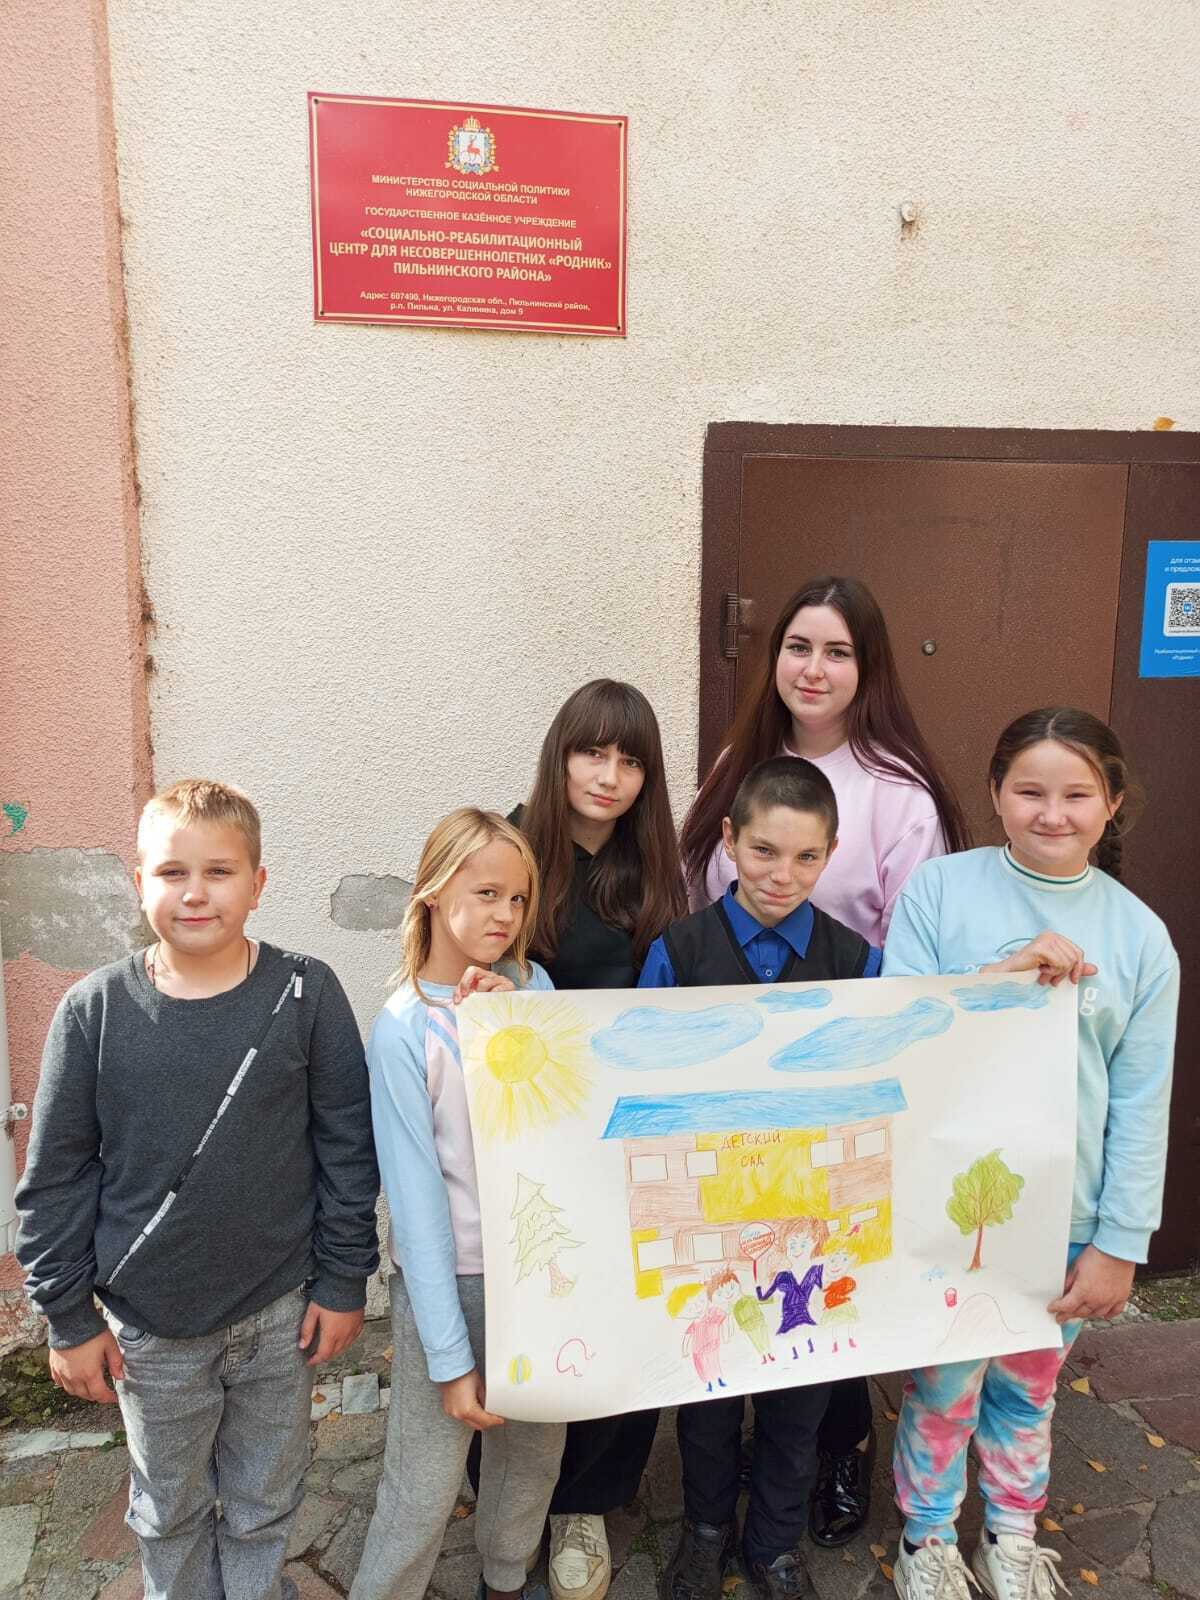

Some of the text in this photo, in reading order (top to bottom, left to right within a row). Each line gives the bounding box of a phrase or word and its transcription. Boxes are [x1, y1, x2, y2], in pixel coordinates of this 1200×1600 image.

[371, 175, 571, 197] МИНИСТЕРСТВО СОЦИАЛЬНОЙ ПОЛИТИКИ
[406, 188, 538, 205] НИЖЕГОРОДСКОЙ ОБЛАСТИ
[365, 206, 577, 228] ГОСУДАРСТВЕННОЕ КАЗЁННОЕ УЧРЕЖДЕНИЕ
[360, 226, 582, 251] «СОЦИАЛЬНО-РЕАБИЛИТАЦИОННЫЙ
[329, 242, 612, 270] ЦЕНТР ДЛЯ НЕСОВЕРШЕННОЛЕТНИХ «РОДНИК»
[393, 263, 552, 282] ПИЛЬНИНСКОГО РАЙОНА»
[360, 291, 388, 301] Адрес:
[422, 293, 486, 305] Нижегородская
[509, 298, 563, 309] Пильнинский
[564, 301, 591, 311] район,
[407, 302, 439, 313] Пильна,
[442, 306, 455, 314] ул.
[457, 304, 498, 315] Калинина,
[500, 308, 517, 316] дом
[518, 307, 524, 315] 9
[721, 1128, 783, 1149] ДЕТСКИЙ
[740, 1155, 766, 1169] САД
